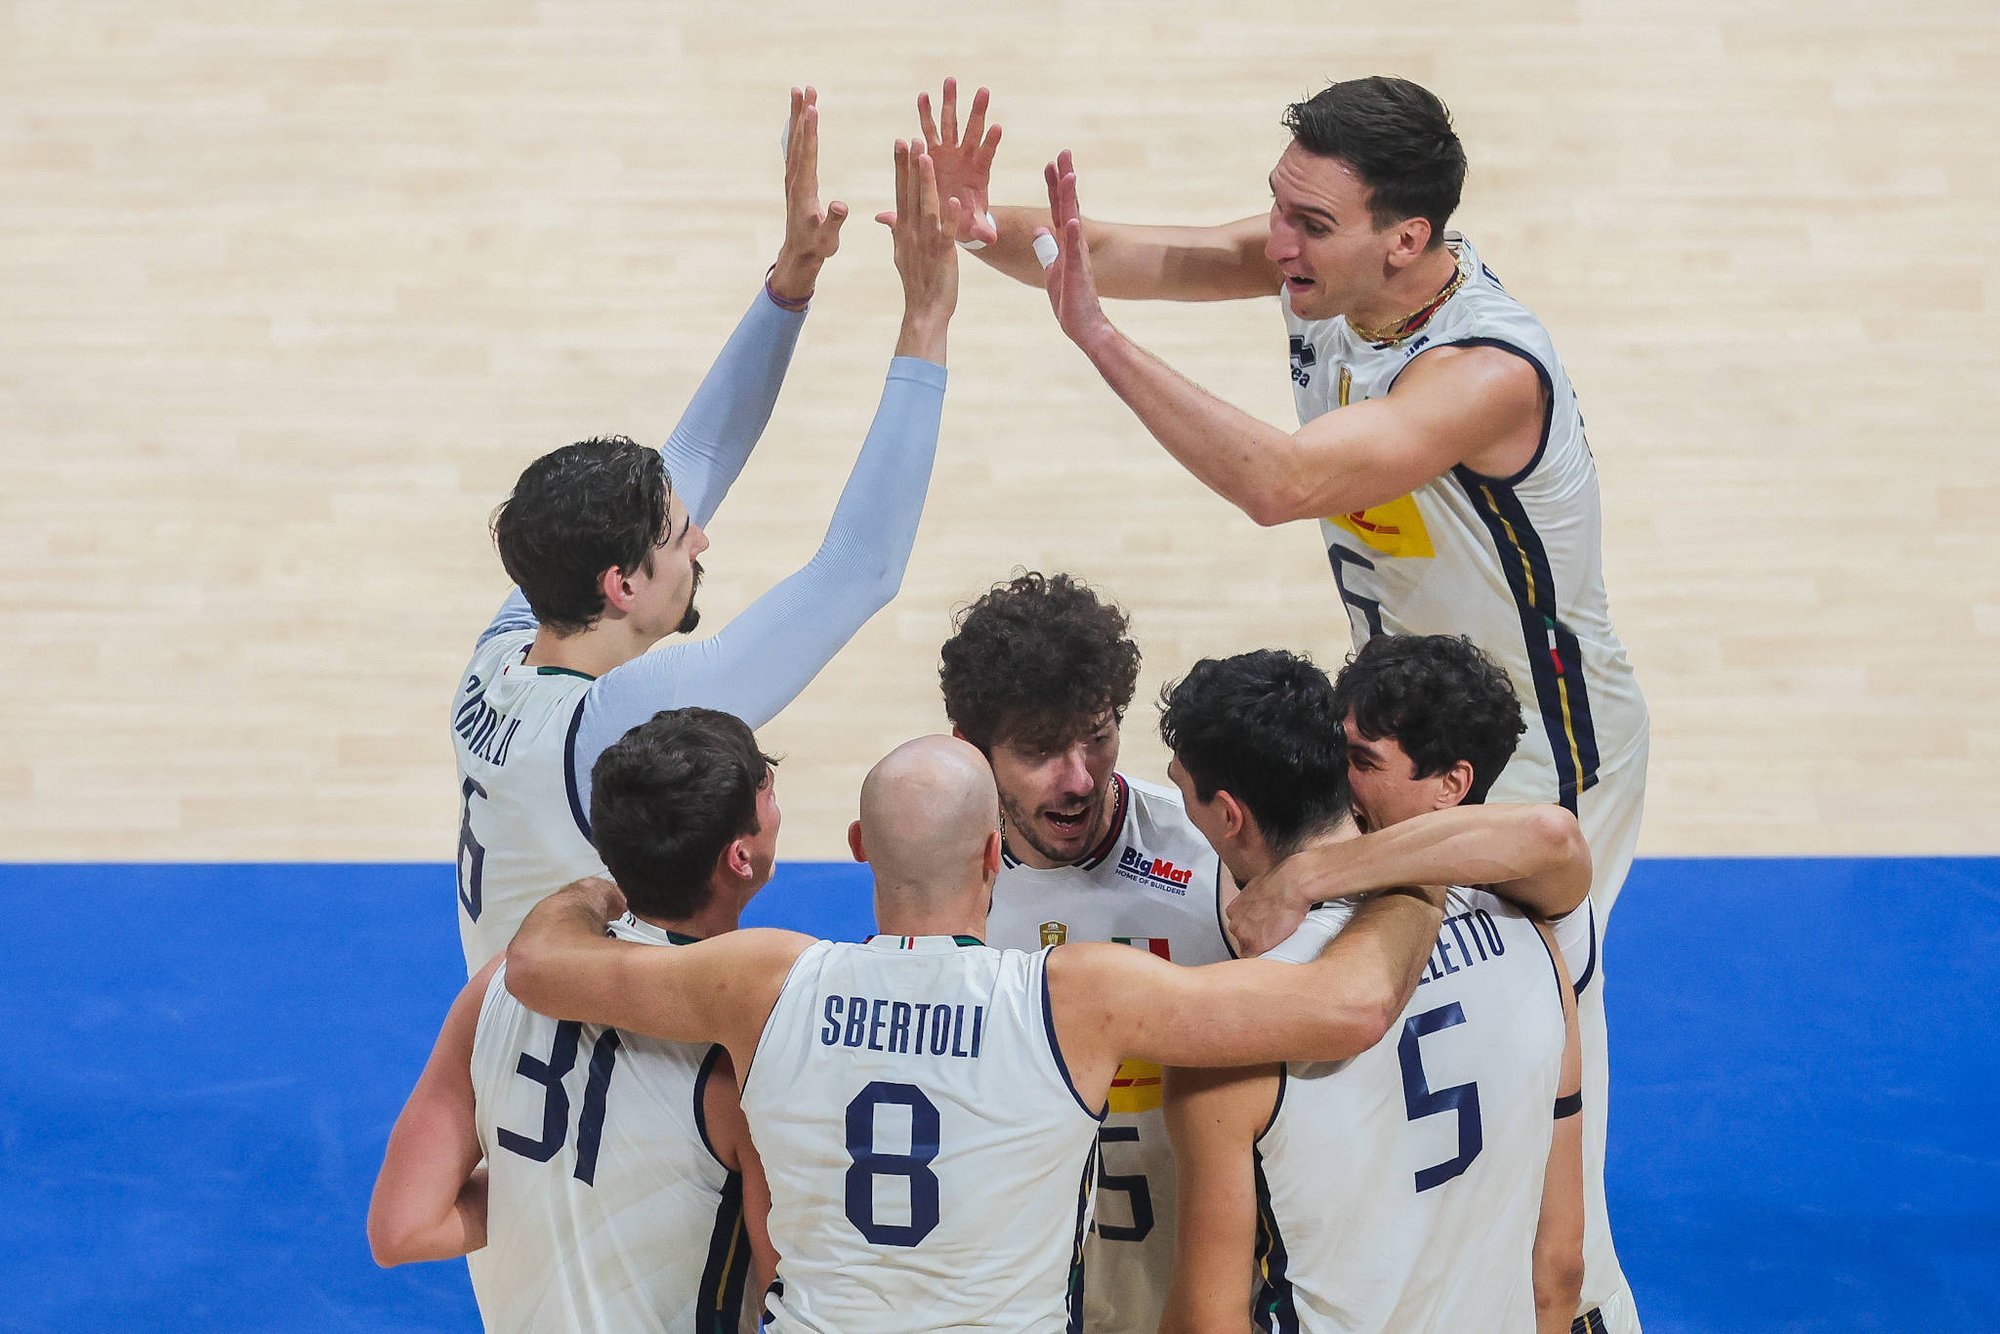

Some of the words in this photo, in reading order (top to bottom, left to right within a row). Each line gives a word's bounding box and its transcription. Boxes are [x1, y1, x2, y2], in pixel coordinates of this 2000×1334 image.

[457, 773, 487, 924] 6
[1115, 868, 1138, 882] HOME
[1139, 876, 1151, 886] OF
[1149, 881, 1187, 897] BUILDERS
[1120, 846, 1192, 884] BigMat
[821, 994, 983, 1058] SBERTOLI
[1397, 1001, 1483, 1194] 5
[497, 1020, 622, 1188] 31
[845, 1081, 940, 1248] 8
